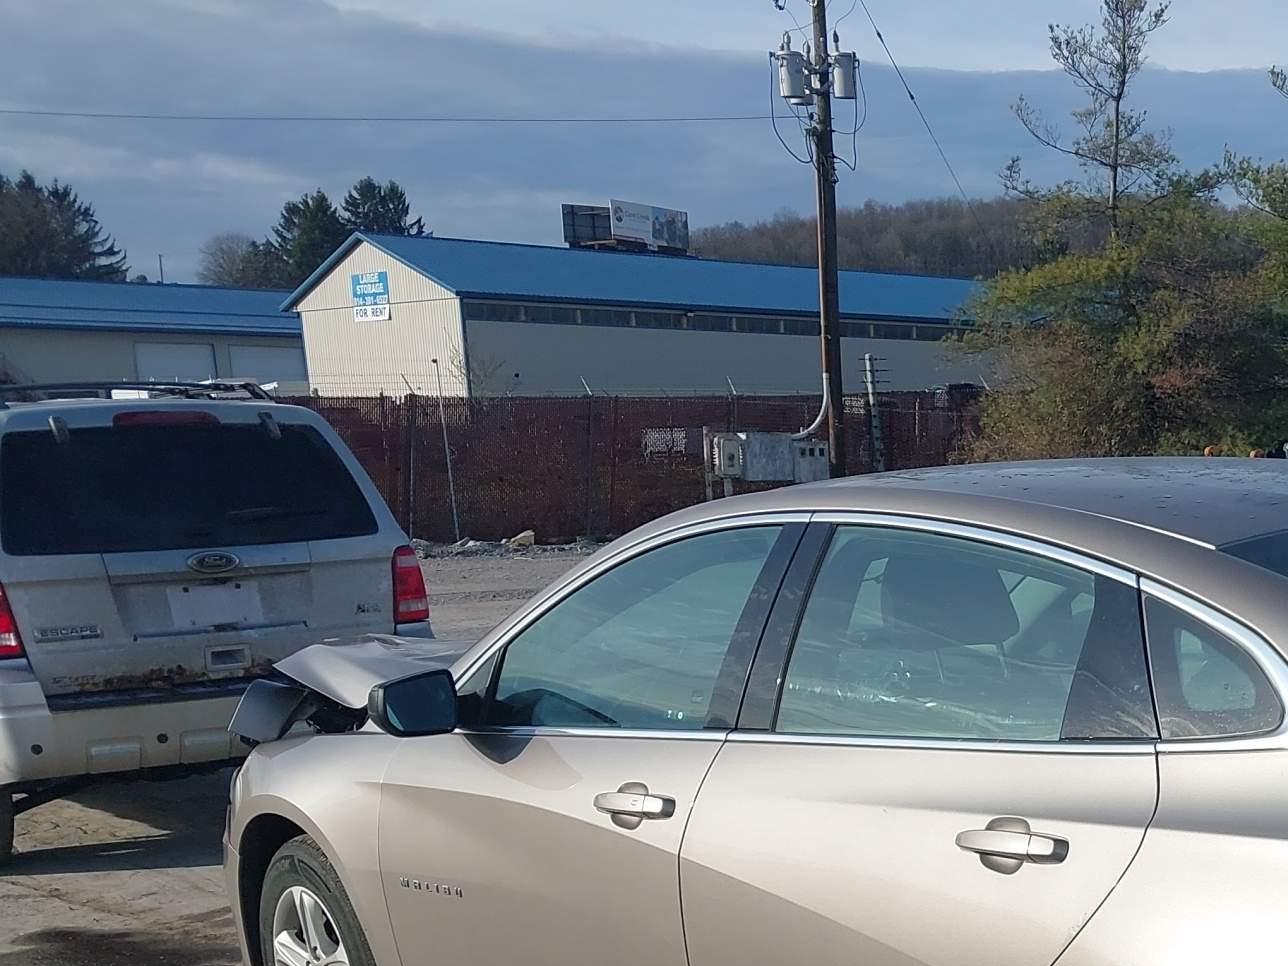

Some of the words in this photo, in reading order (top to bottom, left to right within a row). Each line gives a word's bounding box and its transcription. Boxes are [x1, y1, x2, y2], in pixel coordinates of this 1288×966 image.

[359, 272, 379, 284] LARGE
[356, 282, 385, 295] STORAGE
[355, 308, 368, 318] FOR
[371, 307, 387, 317] RENT
[40, 625, 97, 638] ESCAPE
[399, 876, 464, 899] MALIBU
